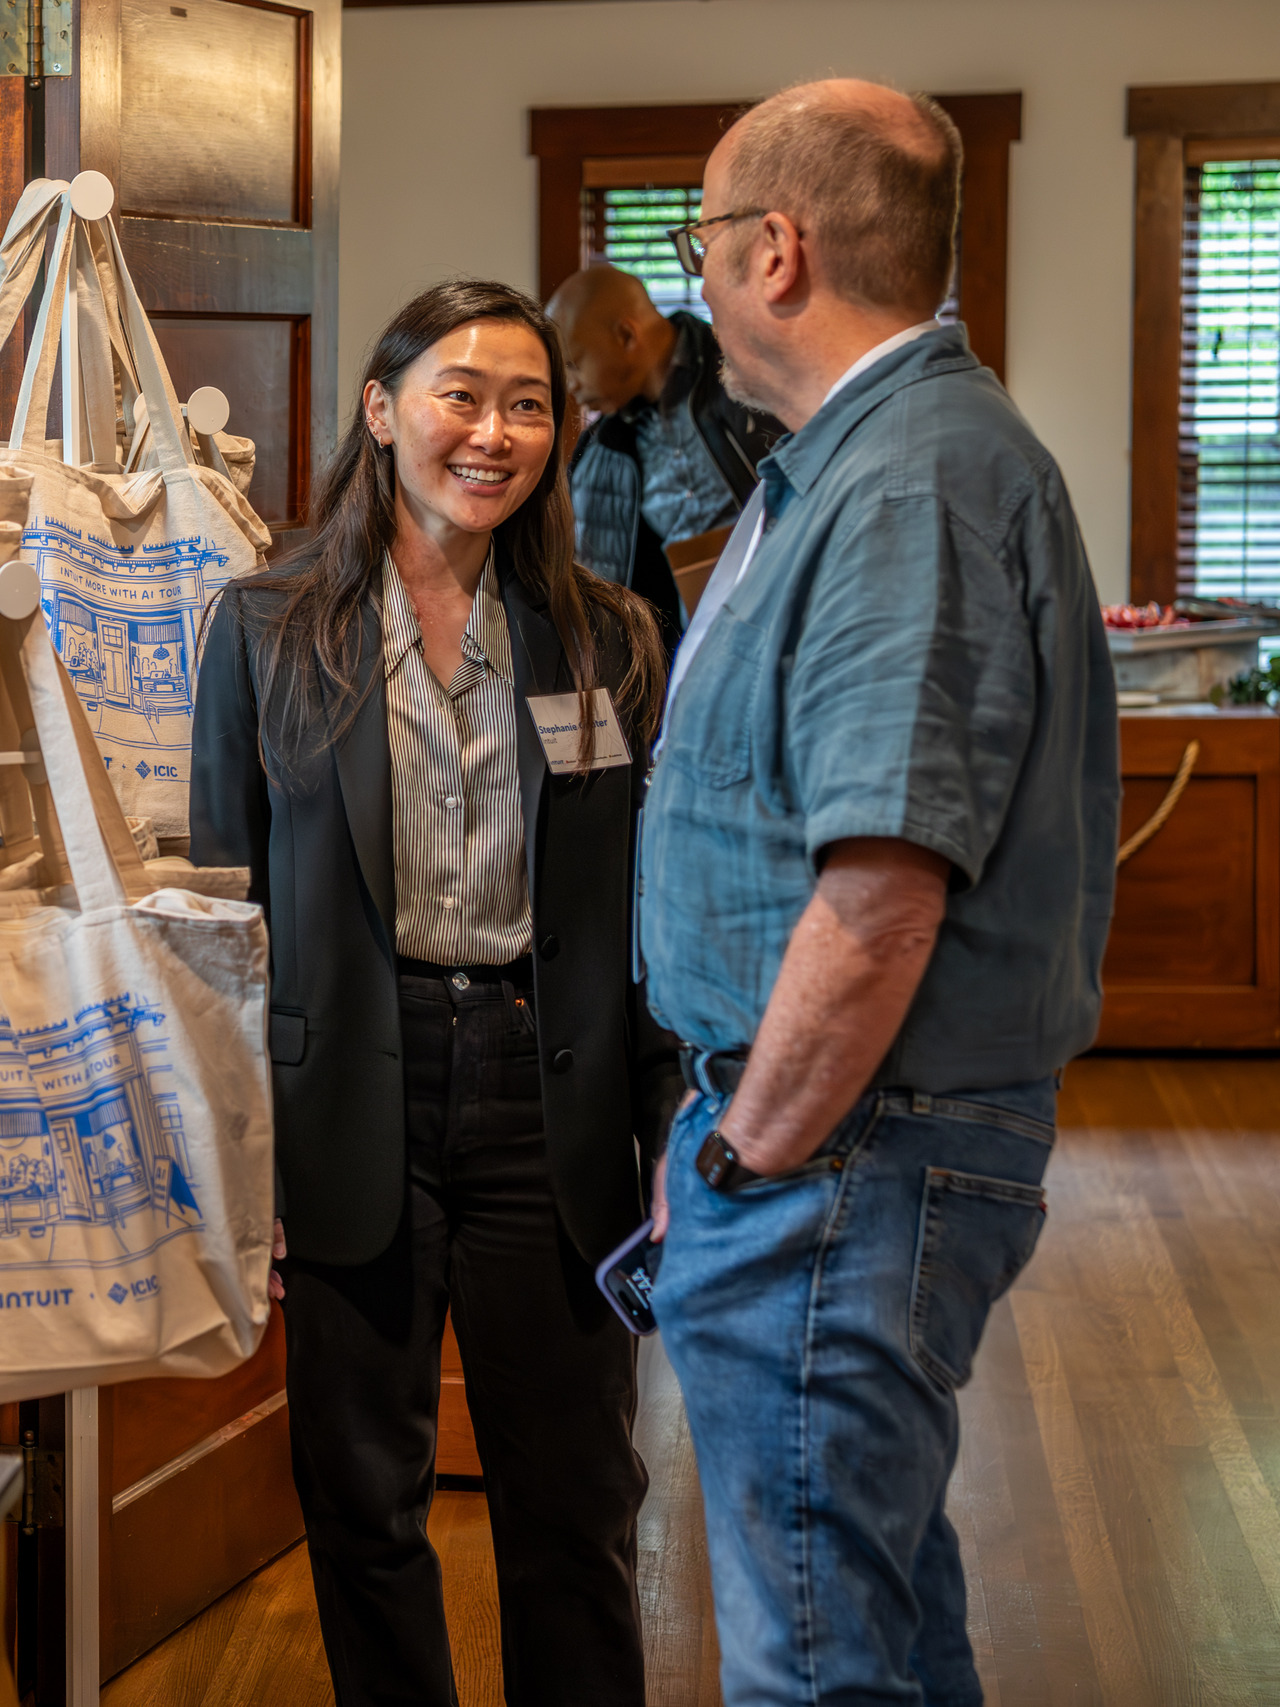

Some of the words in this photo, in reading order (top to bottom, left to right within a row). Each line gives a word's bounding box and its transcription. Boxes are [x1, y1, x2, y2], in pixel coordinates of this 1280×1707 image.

[60, 566, 83, 583] INTUIT
[85, 578, 107, 595] MORE
[109, 587, 137, 600] WITH
[141, 590, 154, 600] AI
[158, 585, 182, 599] TOUR
[538, 723, 577, 735] Stephanie
[154, 765, 178, 778] ICIC
[42, 1072, 82, 1091] WITH
[130, 1274, 158, 1297] ICIC
